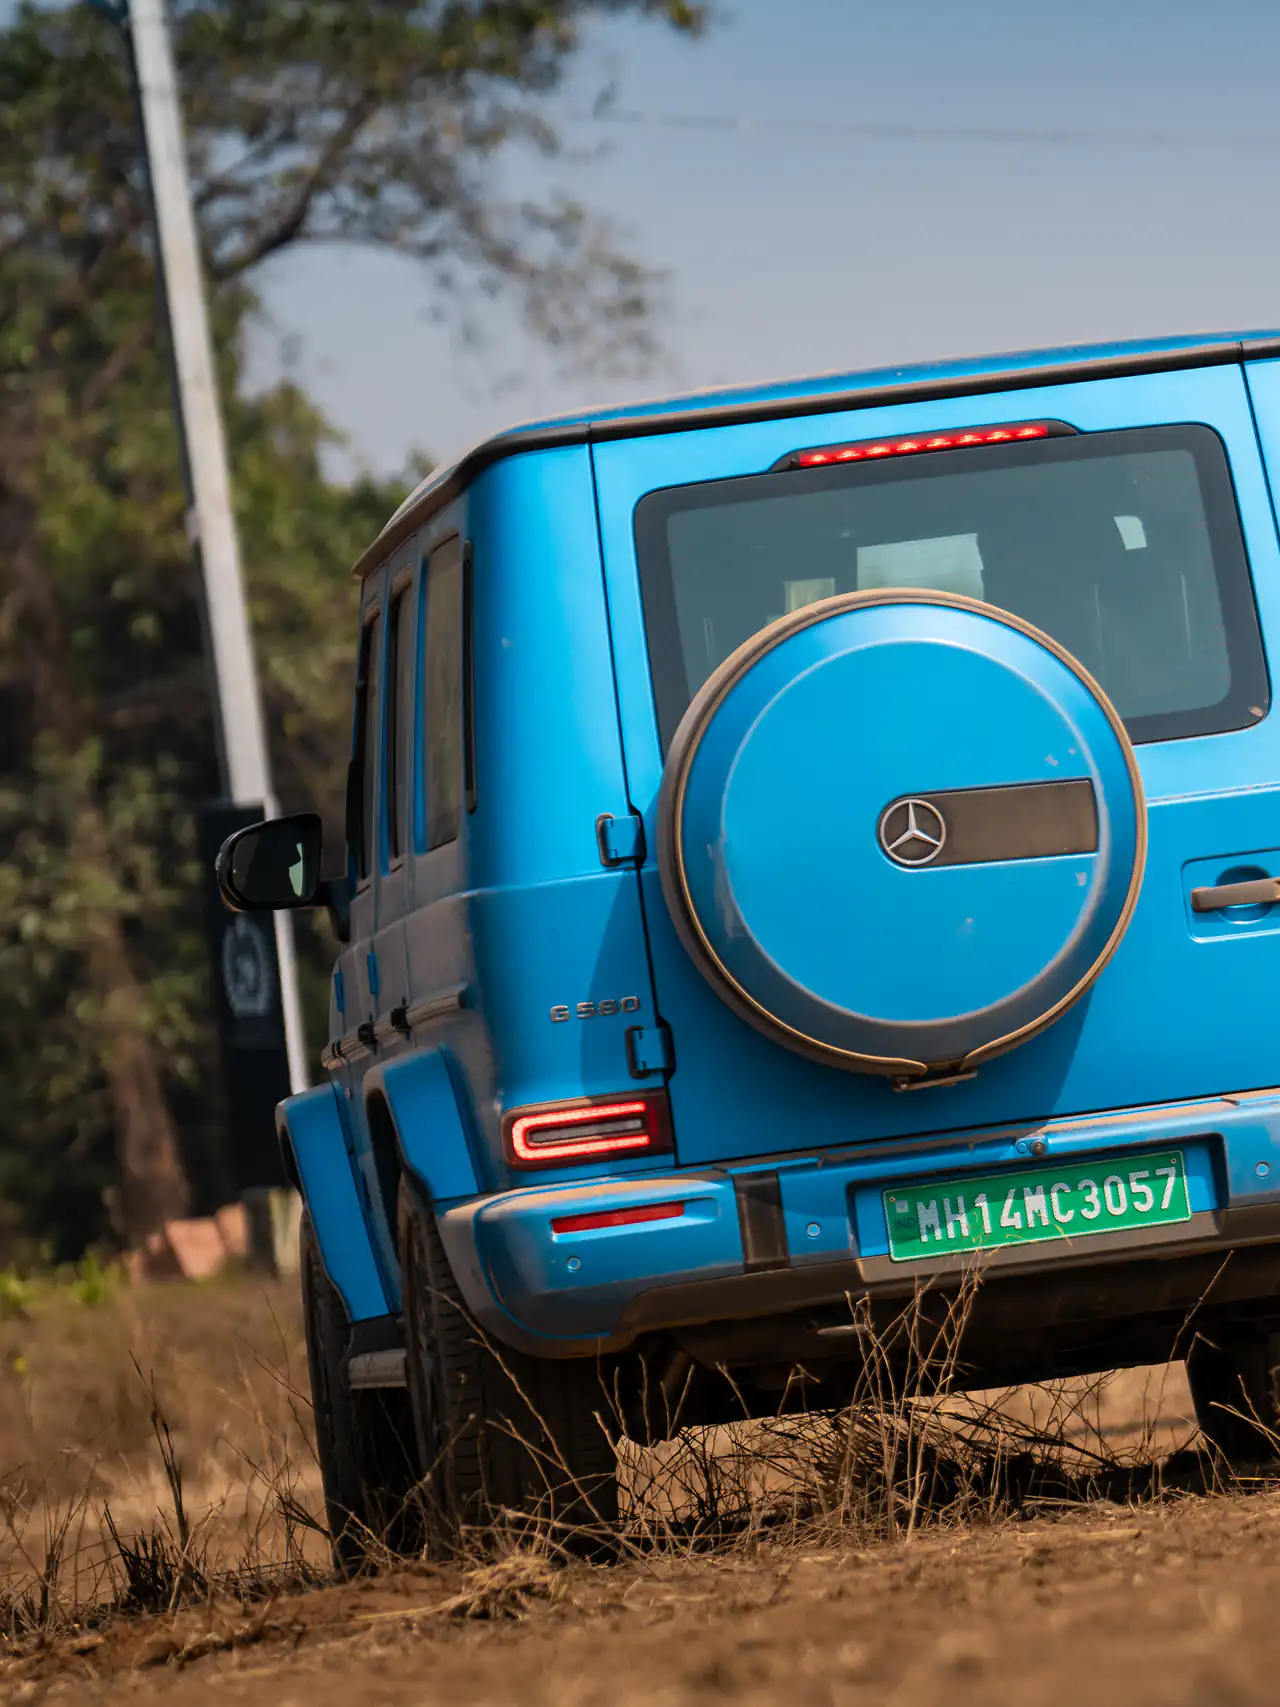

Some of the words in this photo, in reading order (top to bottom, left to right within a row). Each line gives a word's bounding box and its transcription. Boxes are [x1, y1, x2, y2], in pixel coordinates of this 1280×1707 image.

[549, 1004, 571, 1022] G
[576, 995, 640, 1019] 580
[915, 1167, 1177, 1243] MH14MC3057
[894, 1217, 916, 1231] IND
